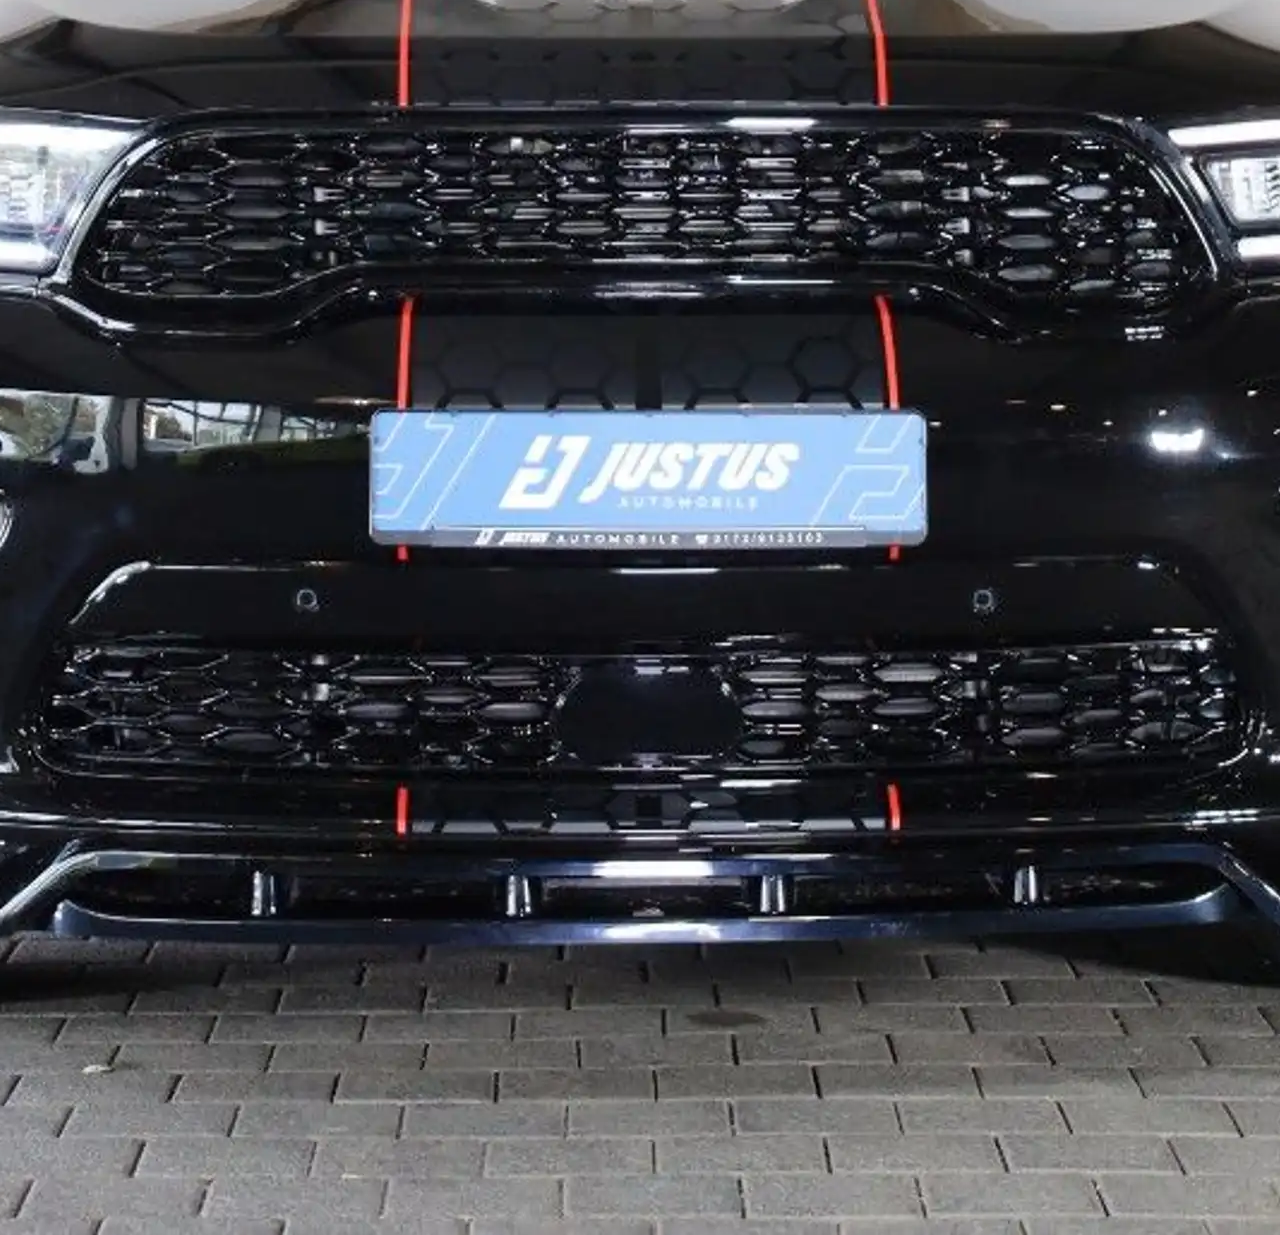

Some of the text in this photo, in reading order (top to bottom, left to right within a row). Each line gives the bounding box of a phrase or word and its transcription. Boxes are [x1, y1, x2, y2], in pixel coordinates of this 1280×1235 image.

[577, 442, 801, 504] JUSTUS
[618, 495, 759, 511] AUTOMOBILE
[555, 533, 680, 546] AUTOMOBILE
